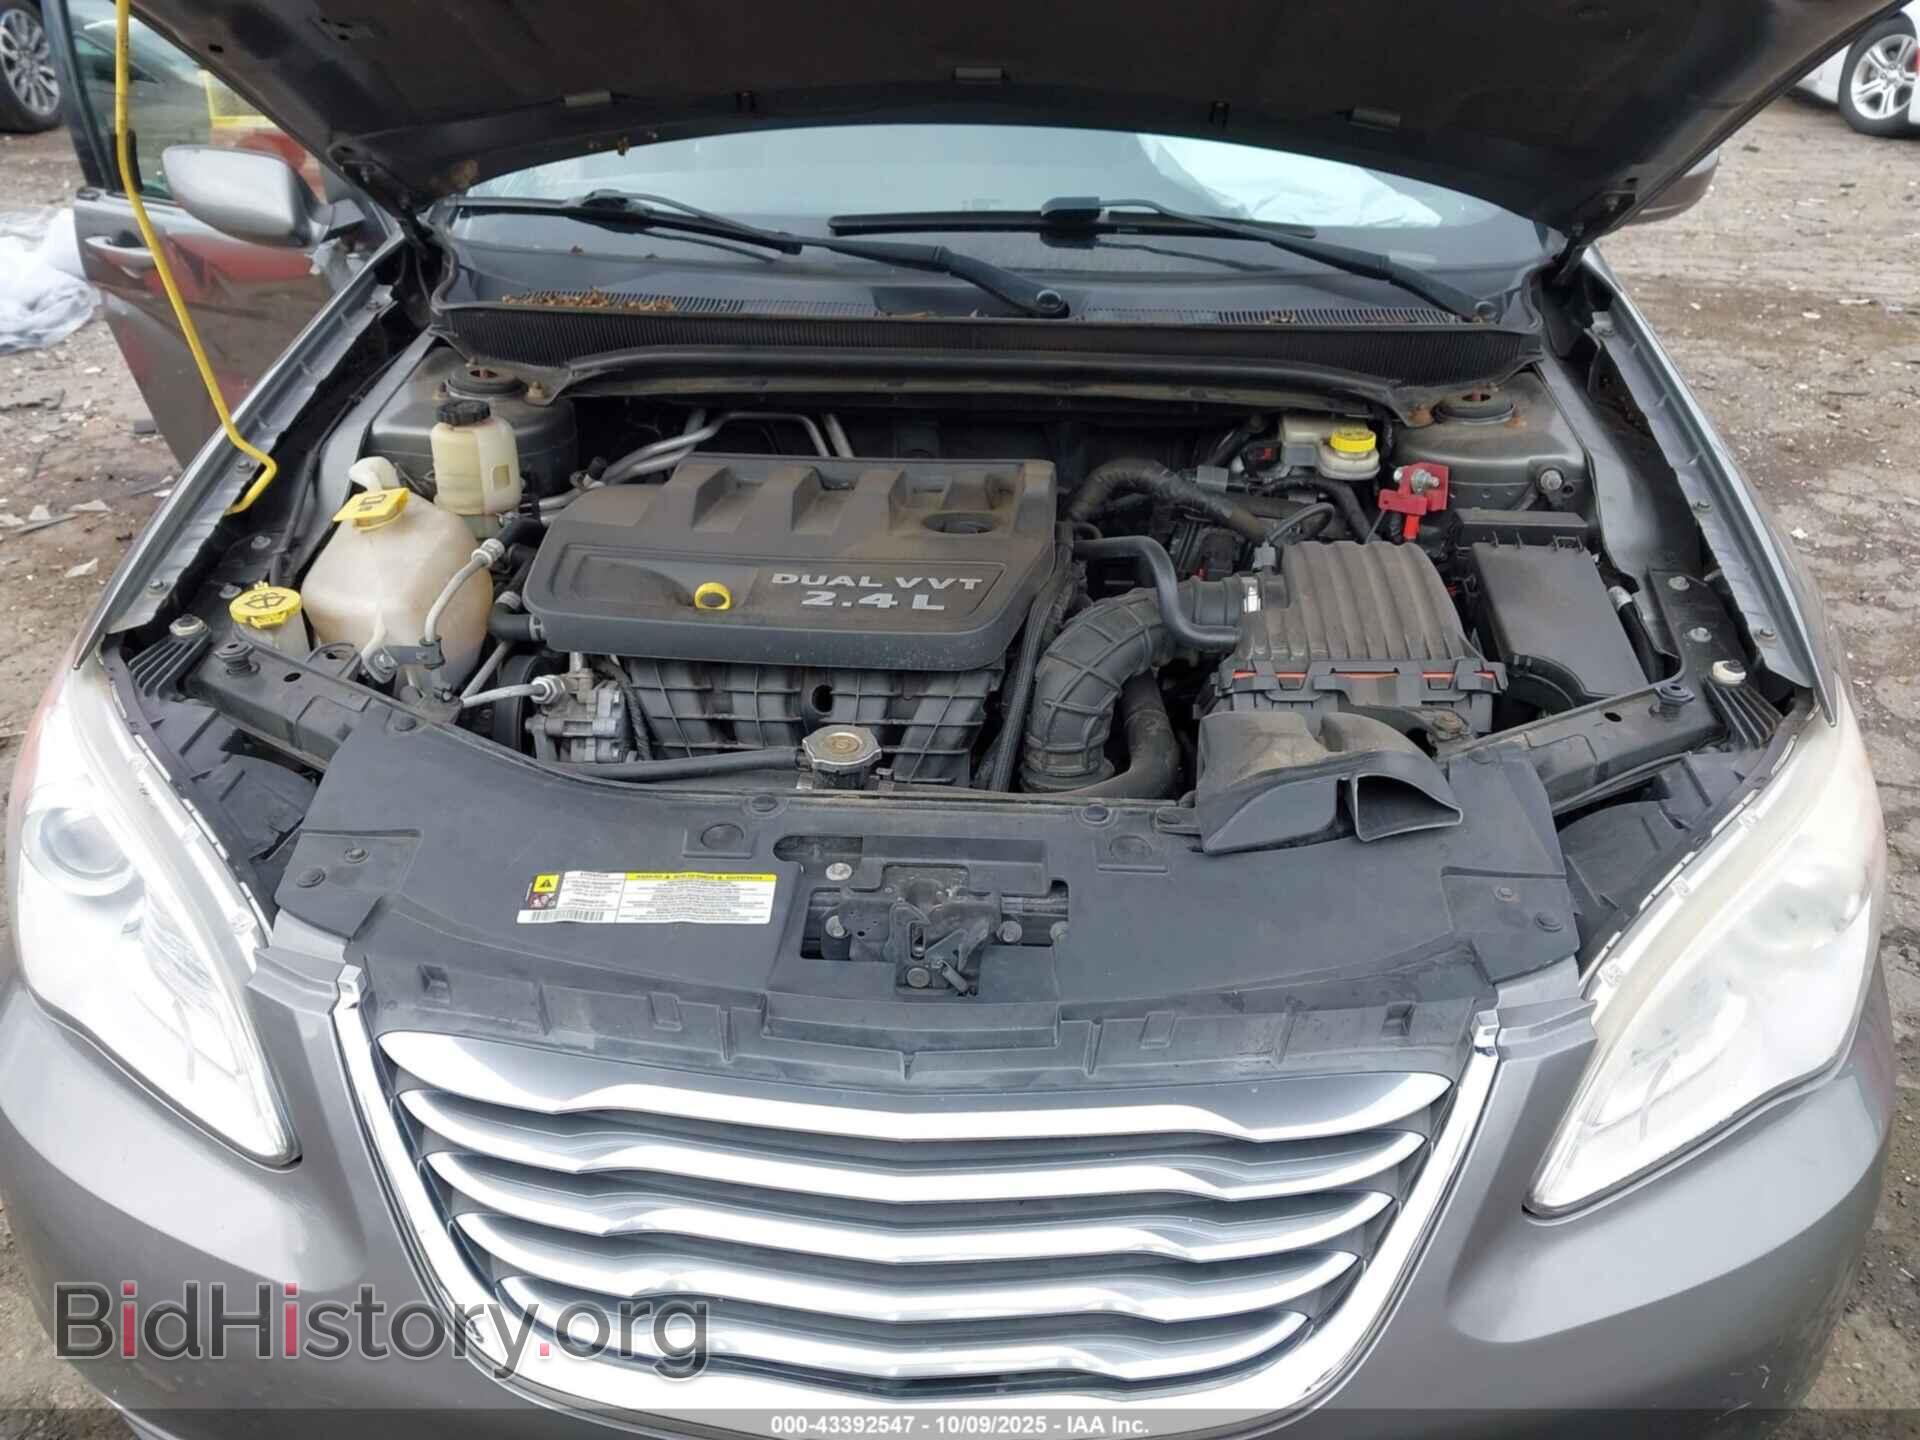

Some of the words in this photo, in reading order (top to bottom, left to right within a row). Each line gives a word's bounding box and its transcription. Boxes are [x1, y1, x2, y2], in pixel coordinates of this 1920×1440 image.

[771, 572, 883, 588] DUAL
[895, 576, 984, 590] VVT
[800, 590, 899, 609] 2.4
[911, 593, 946, 610] L
